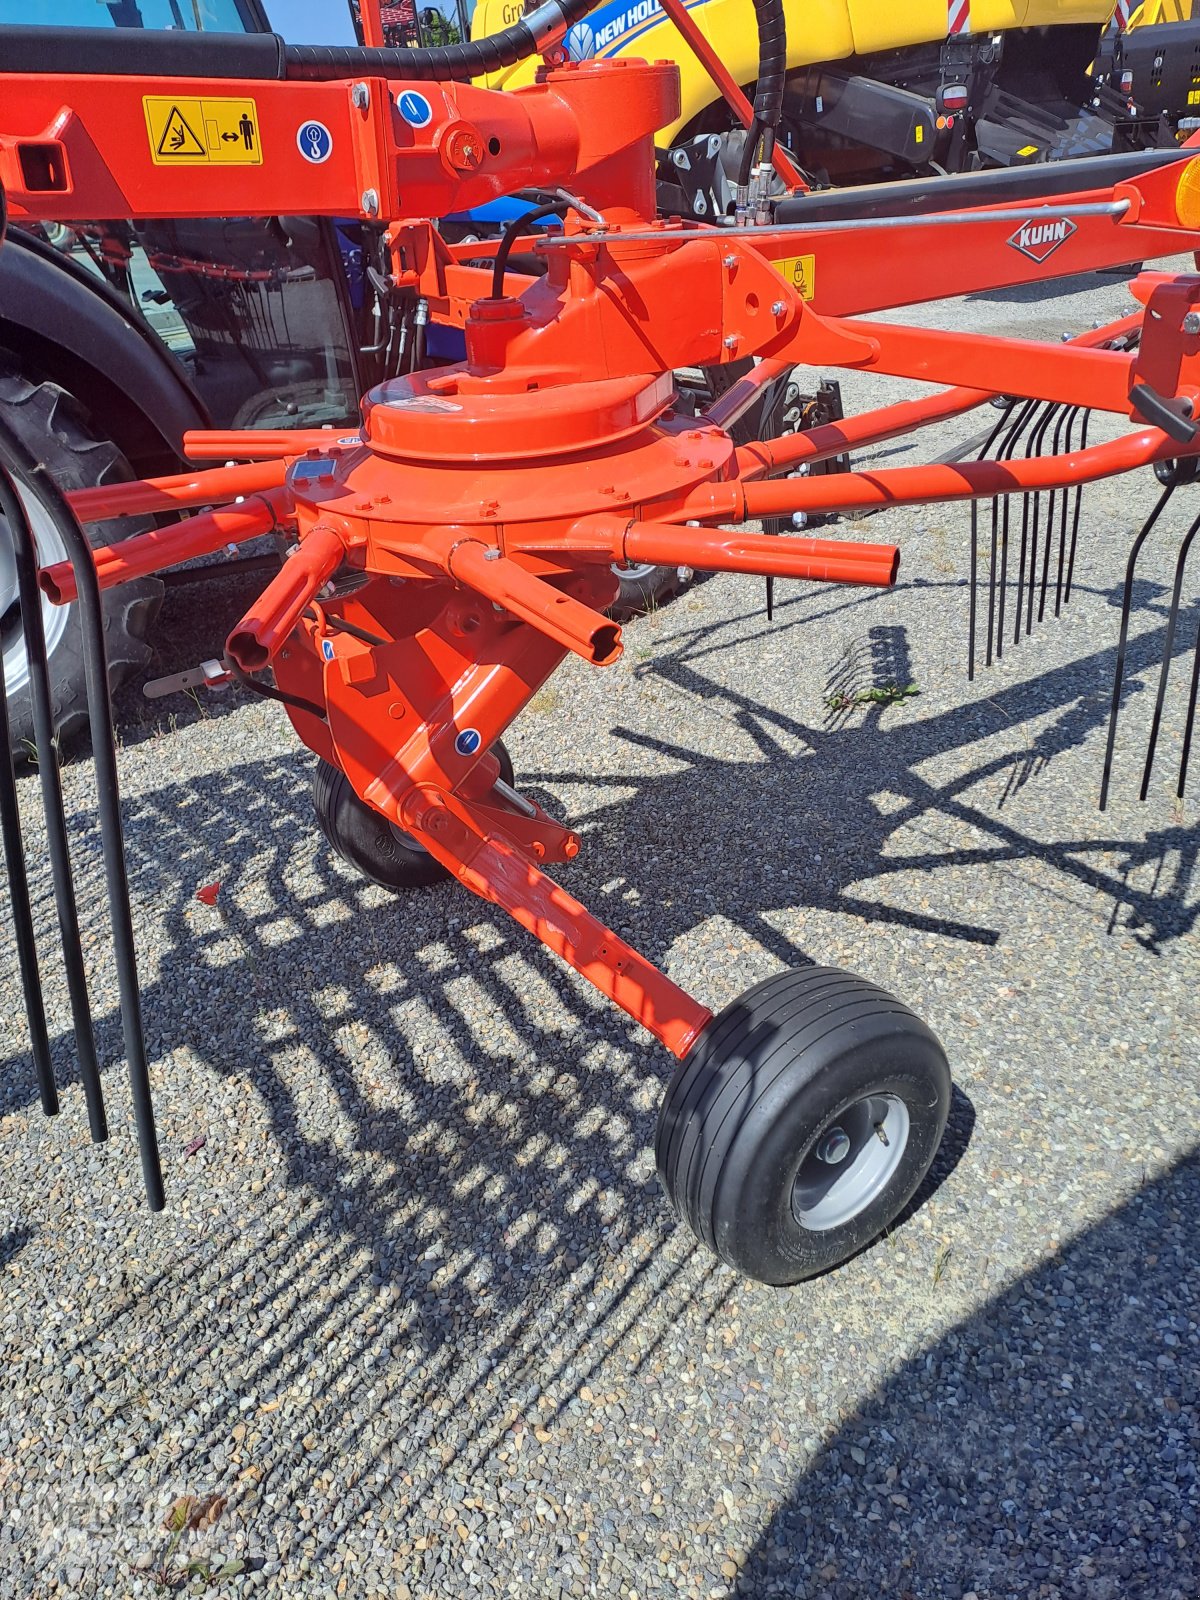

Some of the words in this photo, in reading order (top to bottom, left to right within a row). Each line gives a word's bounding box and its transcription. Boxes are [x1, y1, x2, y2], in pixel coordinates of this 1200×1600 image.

[502, 3, 524, 25] Gro
[595, 13, 626, 50] NEW
[1019, 221, 1066, 248] KUHN
